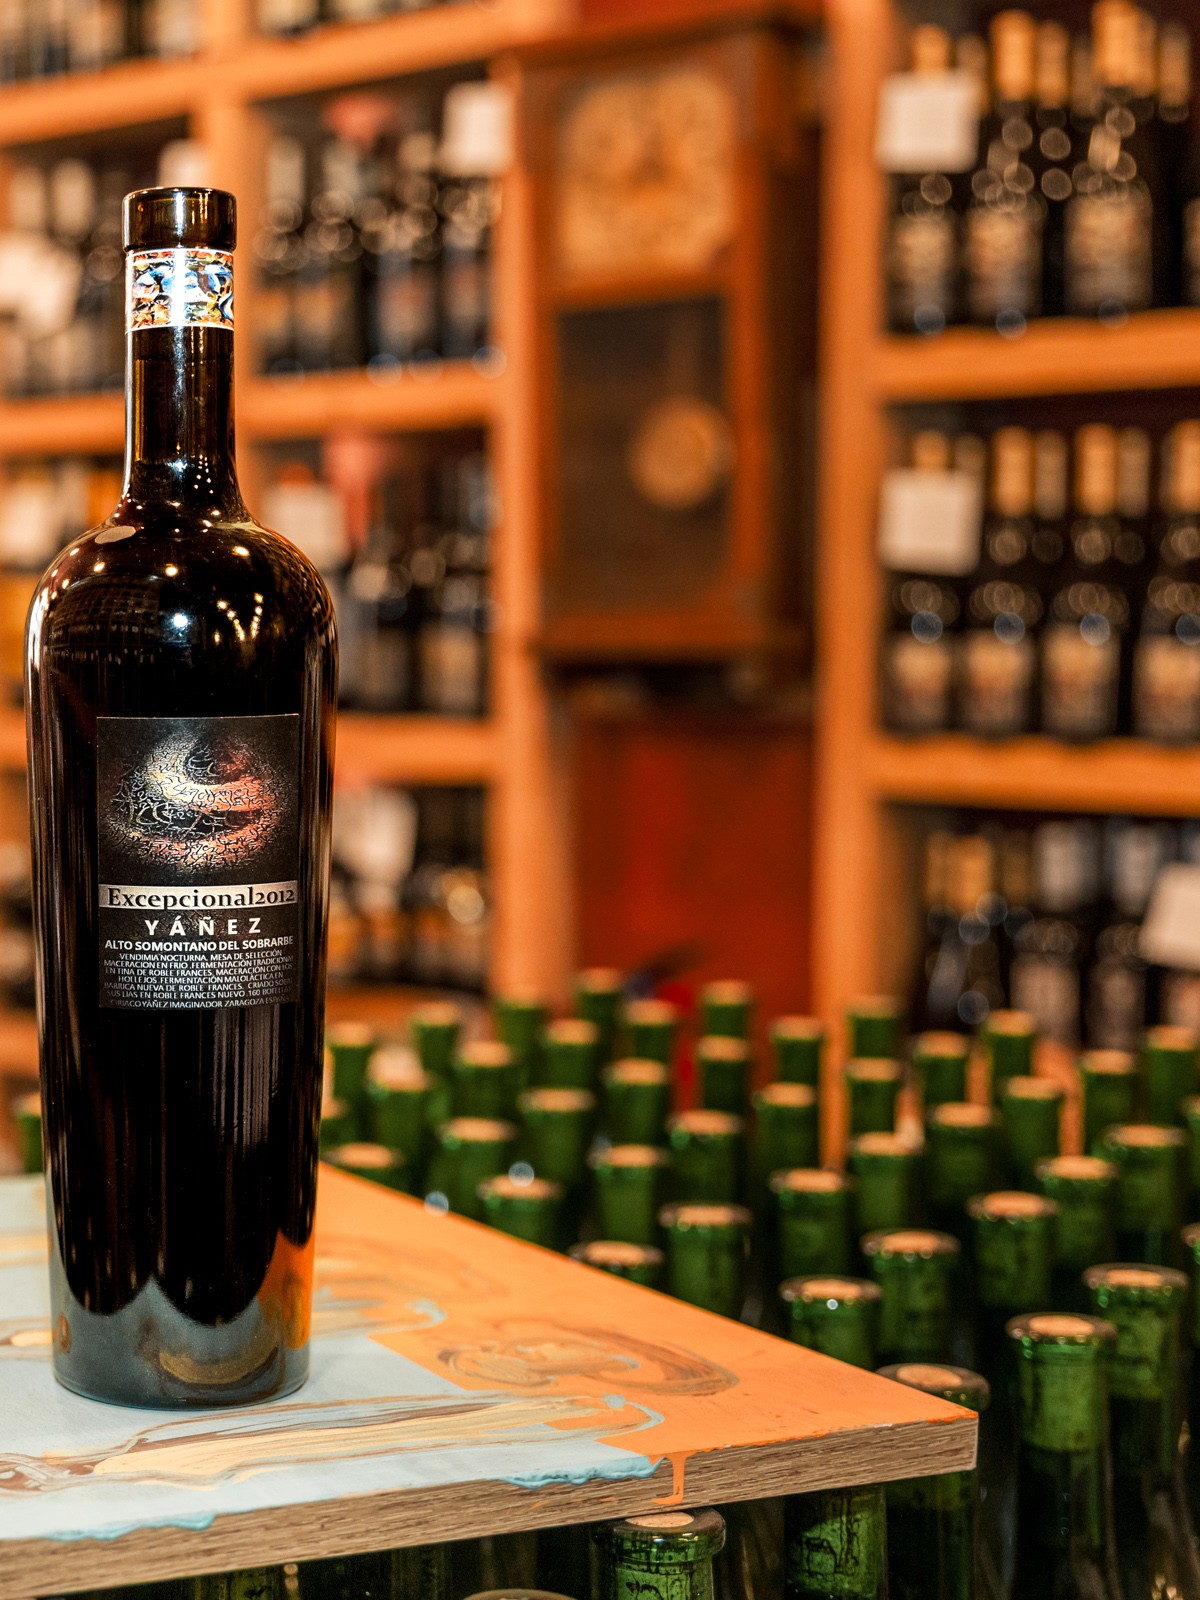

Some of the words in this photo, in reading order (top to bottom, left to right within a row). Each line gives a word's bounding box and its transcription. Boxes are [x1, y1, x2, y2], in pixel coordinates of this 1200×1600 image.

[108, 887, 294, 910] Excepcional2012
[144, 915, 261, 936] YÁÑEZ
[105, 940, 133, 950] ALTO
[135, 941, 217, 952] SOMONTANO
[219, 941, 240, 951] DEL
[242, 936, 293, 950] SOBRARBE
[119, 953, 159, 961] VENDIMIA
[210, 953, 233, 961] MESA
[233, 952, 244, 960] DE
[245, 949, 282, 960] SELECCIÓN
[149, 969, 175, 977] ROBLE
[215, 966, 266, 976] MACERACIÓN
[266, 964, 281, 972] CON
[275, 971, 284, 979] EN
[137, 983, 165, 992] NUEVA
[166, 984, 177, 992] DE
[179, 984, 204, 992] ROBLE
[247, 980, 274, 989] CRIADO
[140, 991, 151, 999] EN
[180, 991, 216, 999] FRANCES
[217, 990, 246, 998] NUEVO
[141, 999, 169, 1008] YÁÑEZ
[169, 1001, 223, 1009] IMAGINADOR
[224, 998, 265, 1008] ZARAGOZA
